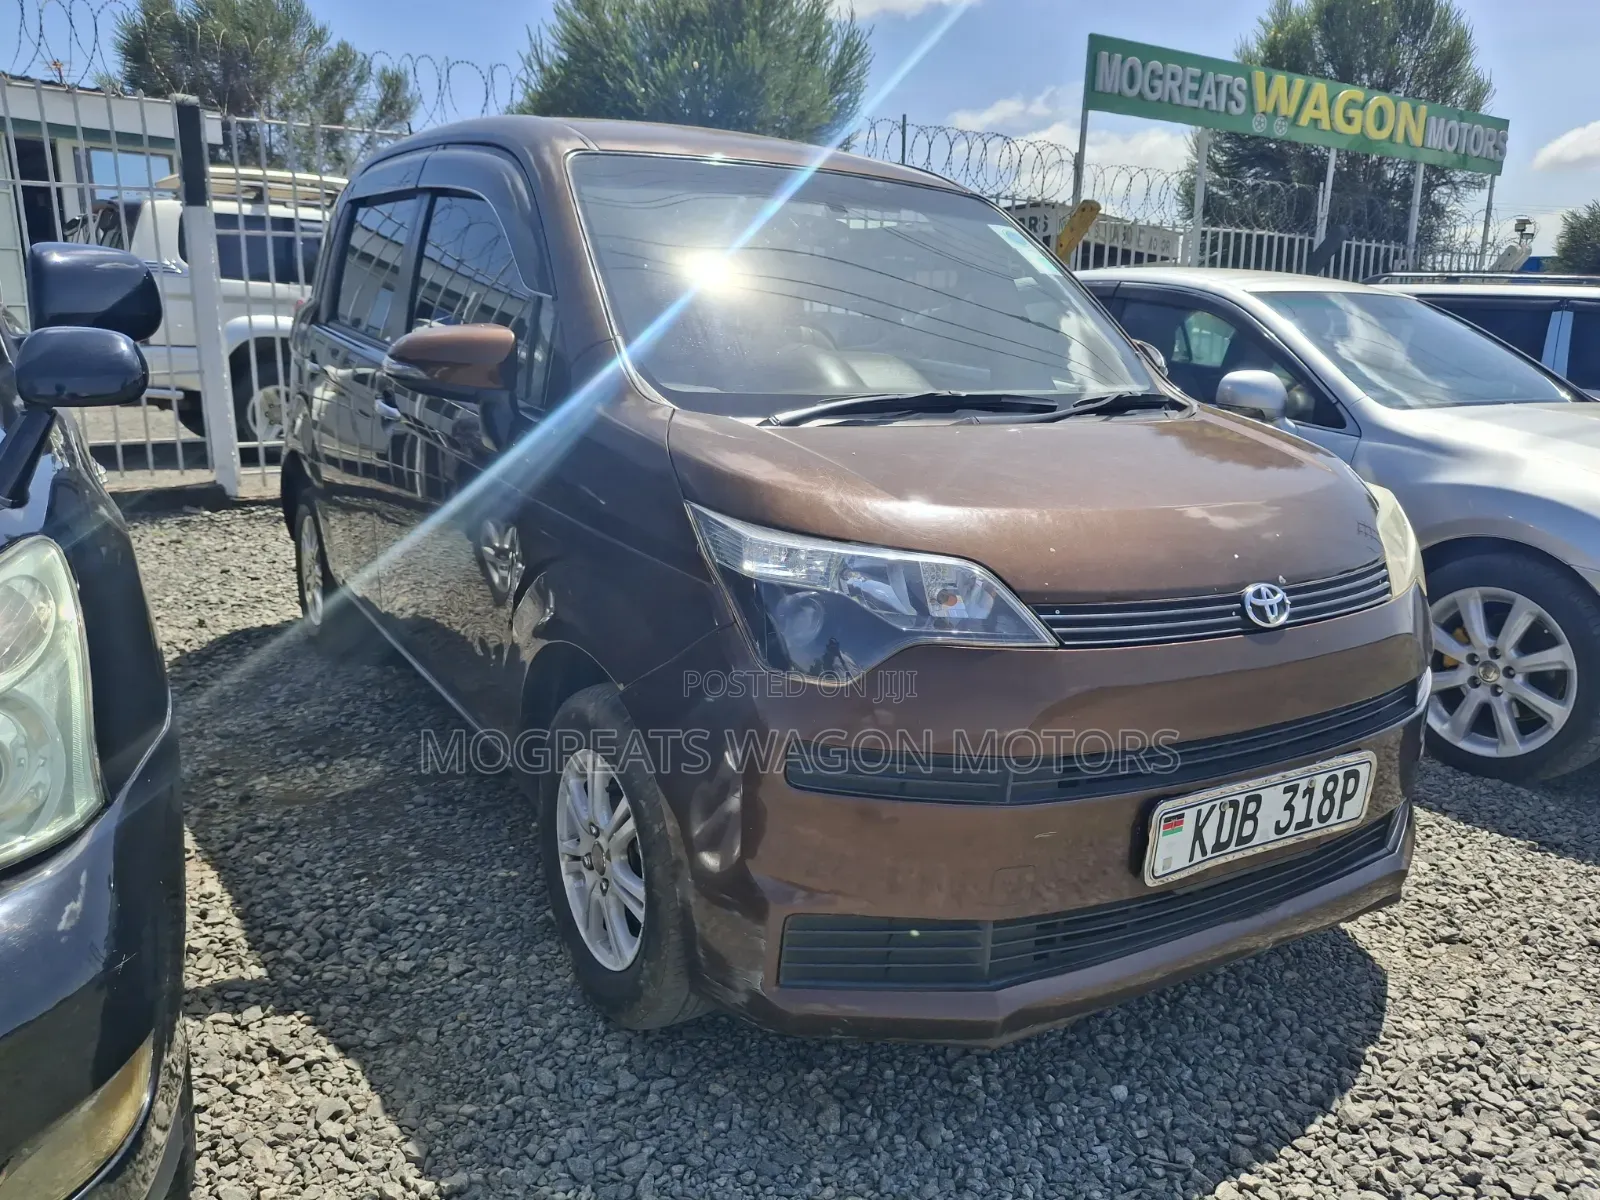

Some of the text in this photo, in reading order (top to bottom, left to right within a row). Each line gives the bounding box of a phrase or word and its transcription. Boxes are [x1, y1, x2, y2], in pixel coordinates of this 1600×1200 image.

[1095, 51, 1508, 160] MOGREATS WAGON MOTORS
[1189, 769, 1360, 863] KDB 318P
